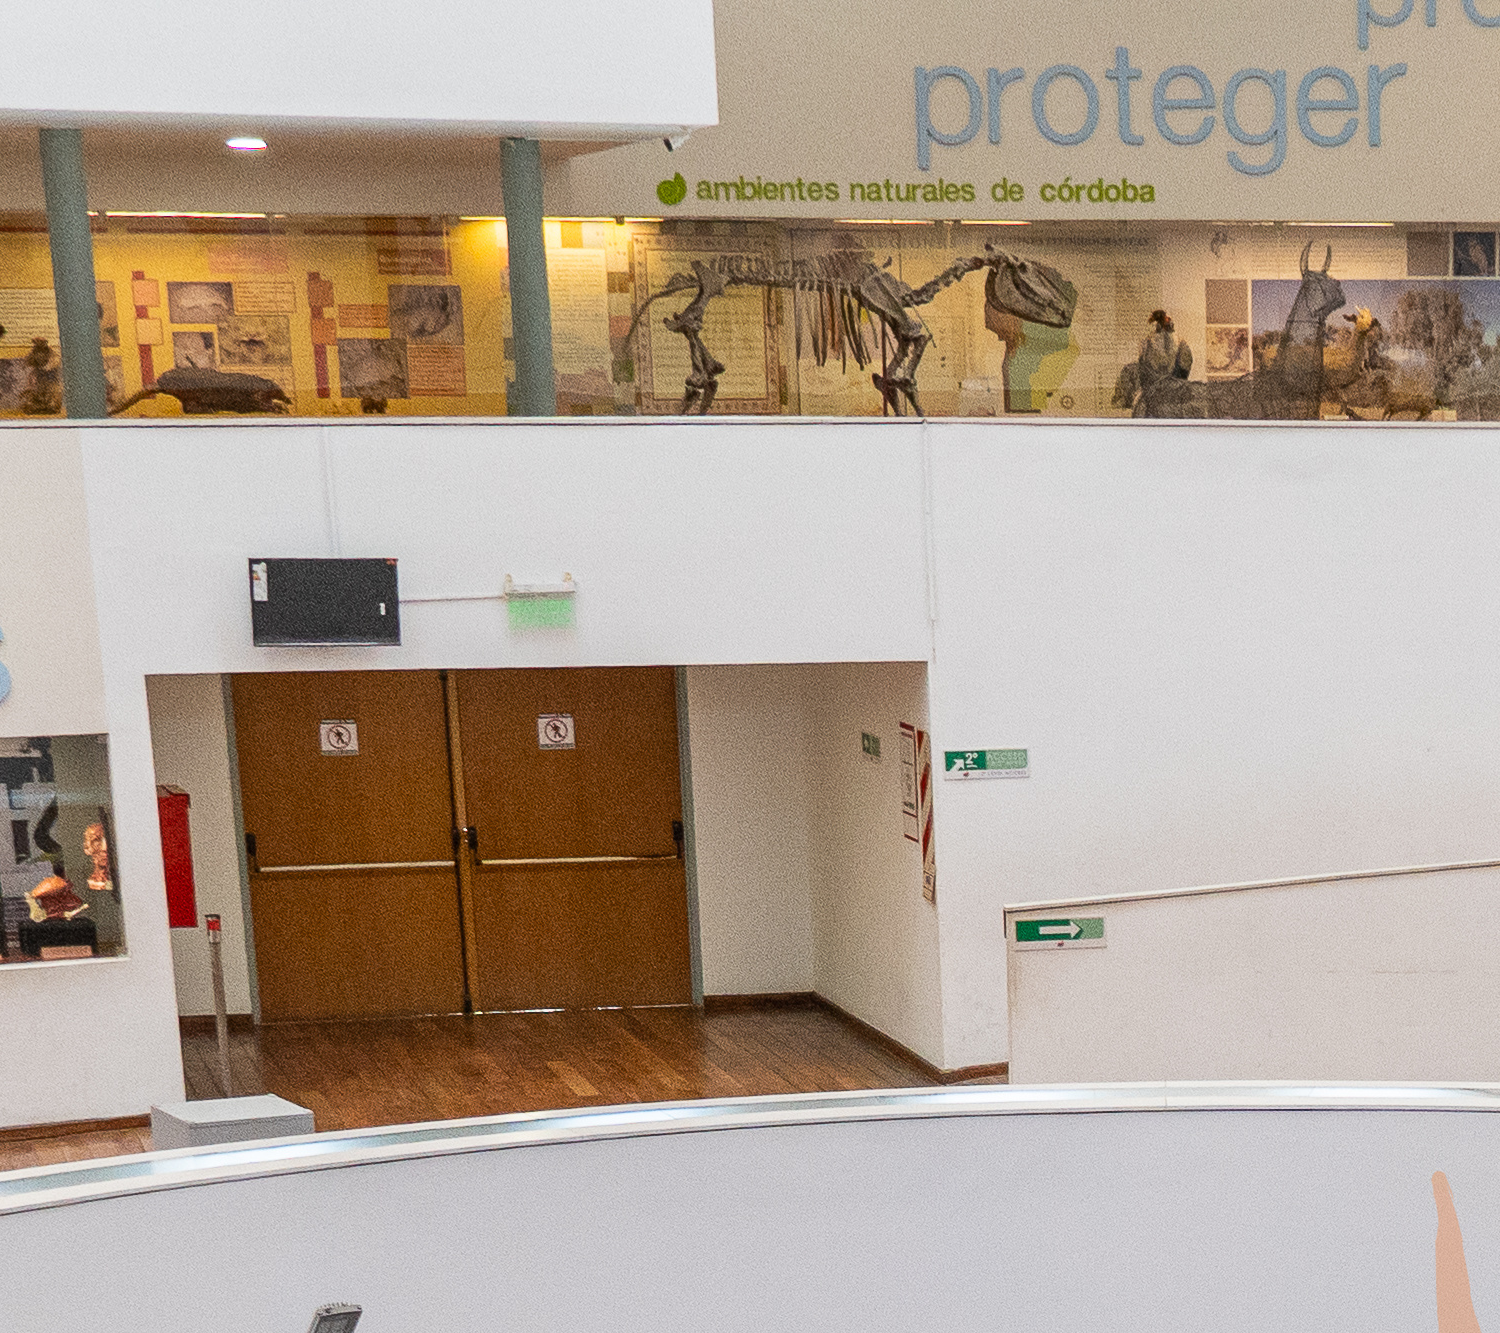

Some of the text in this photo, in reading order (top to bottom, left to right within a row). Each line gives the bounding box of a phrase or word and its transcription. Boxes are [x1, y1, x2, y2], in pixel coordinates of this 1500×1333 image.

[913, 45, 1408, 177] proteger
[695, 174, 1156, 205] ambientes naturales de córdoba
